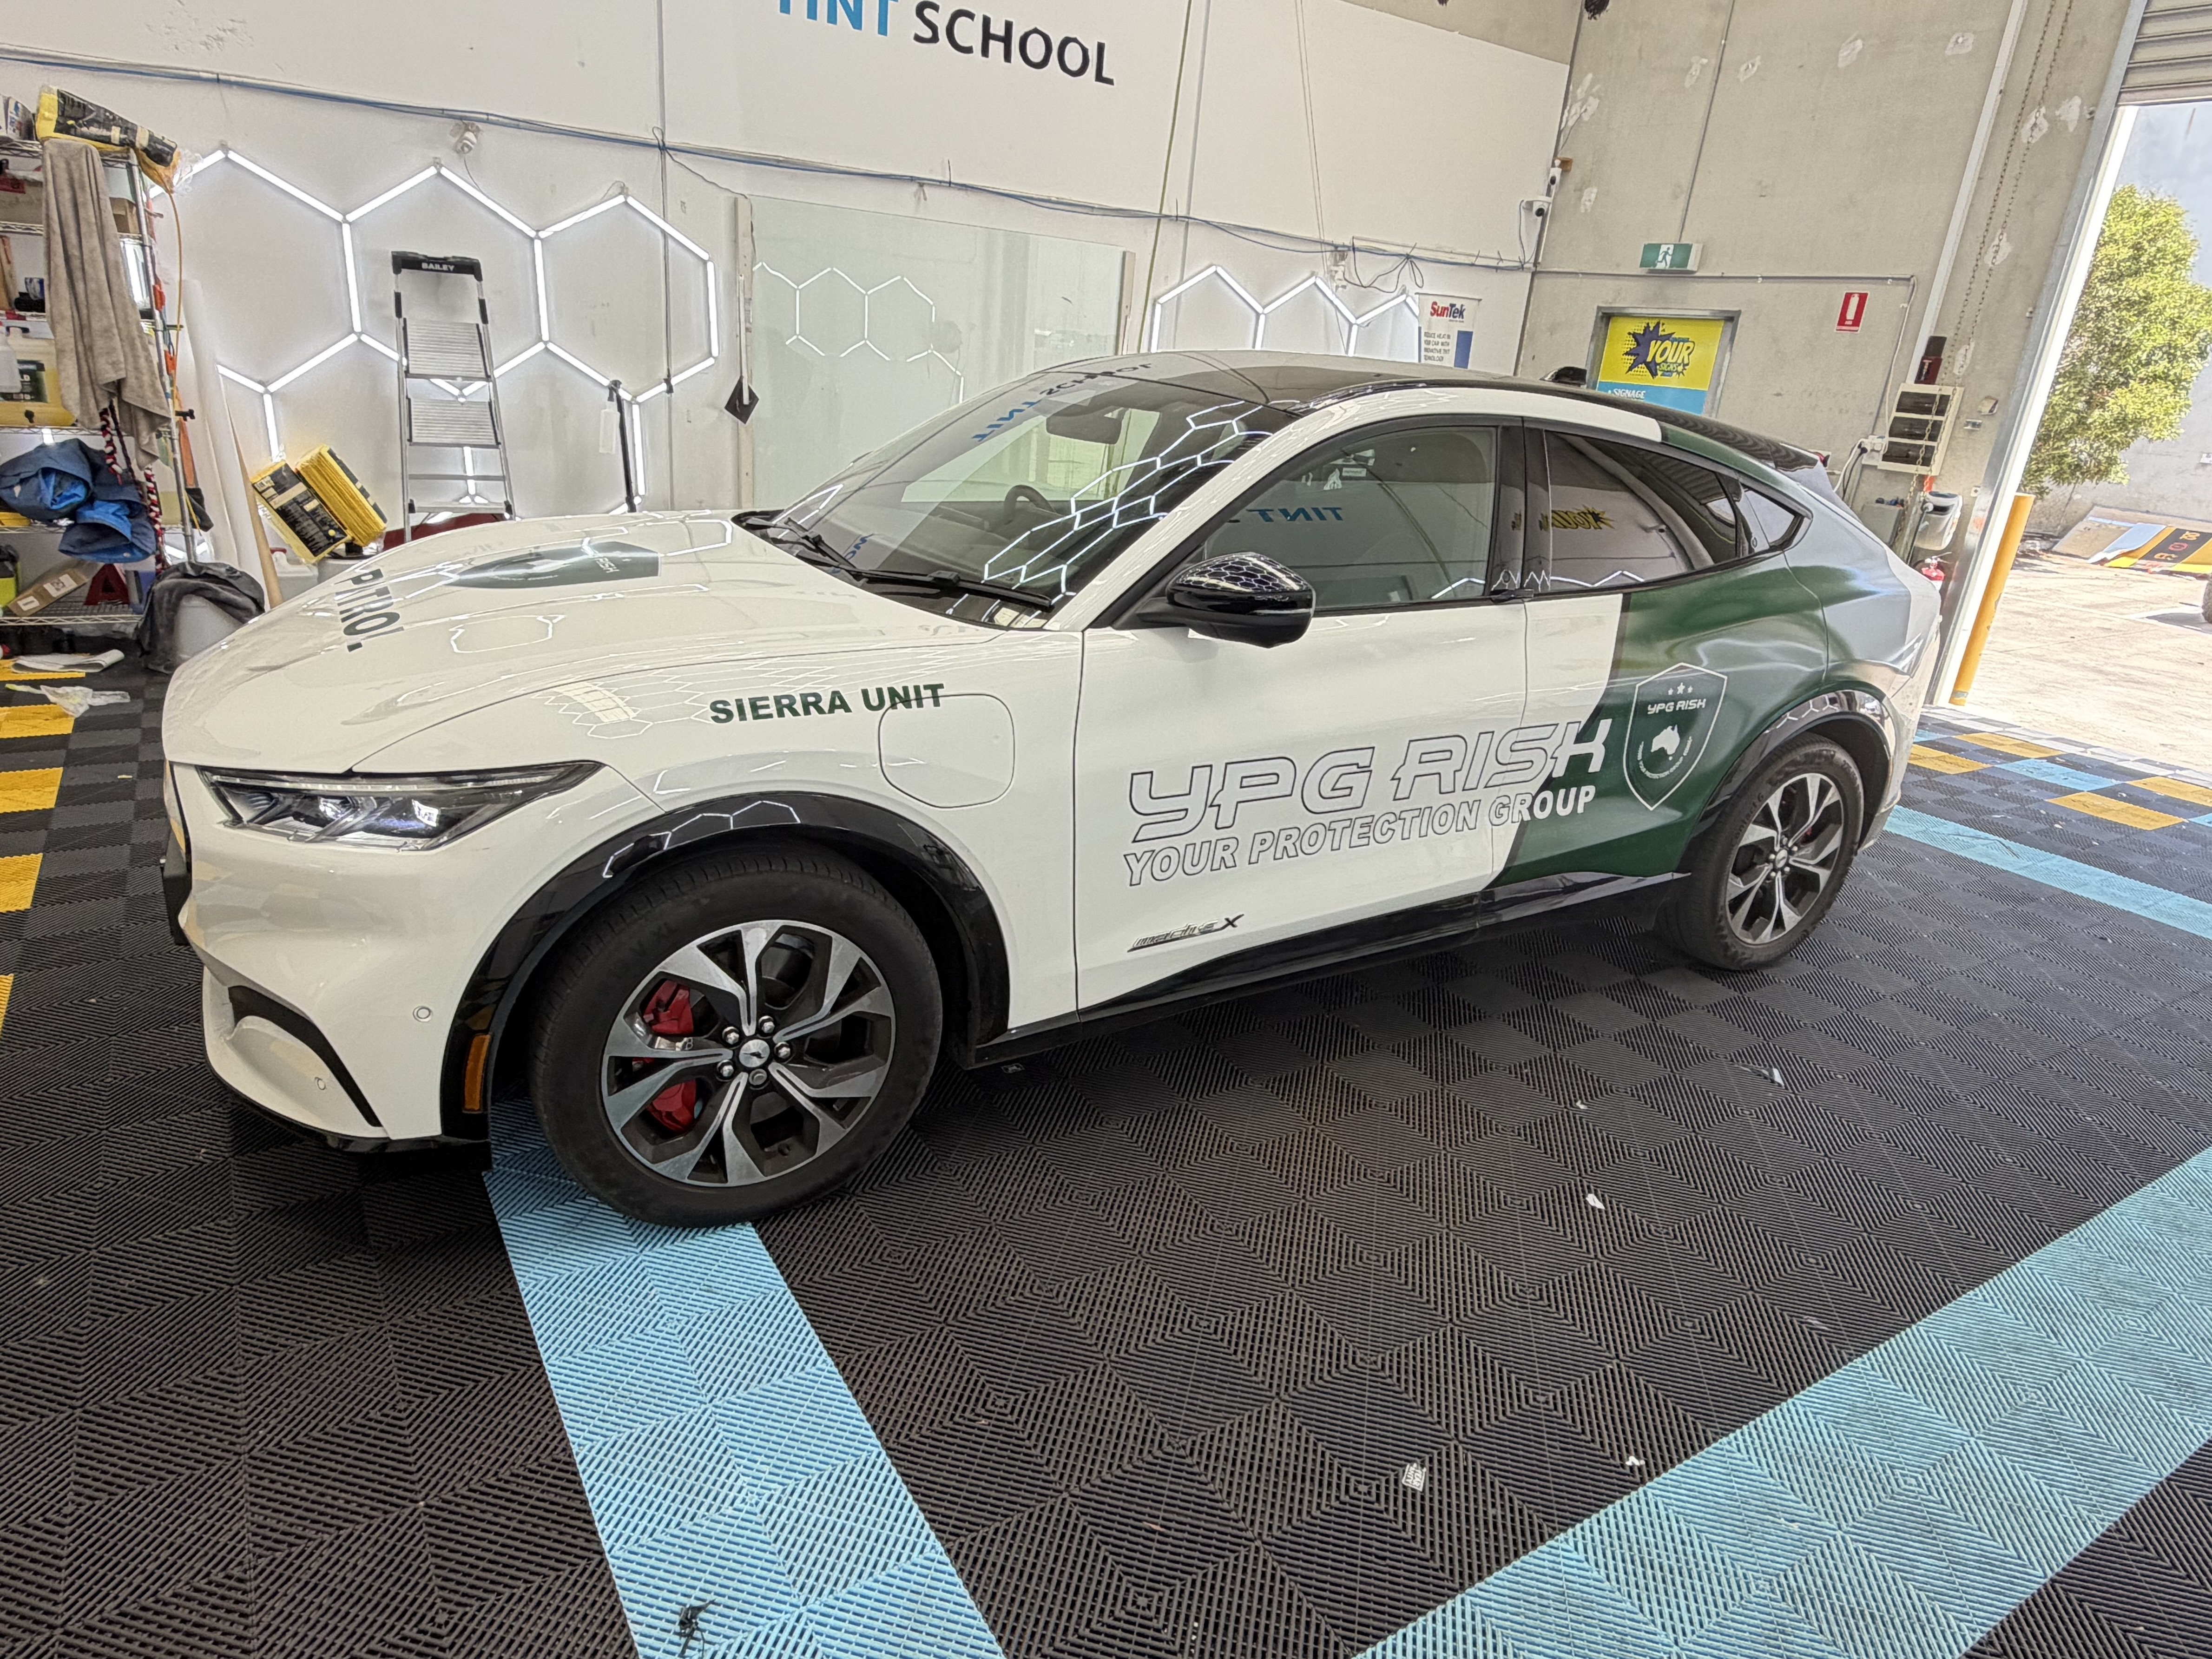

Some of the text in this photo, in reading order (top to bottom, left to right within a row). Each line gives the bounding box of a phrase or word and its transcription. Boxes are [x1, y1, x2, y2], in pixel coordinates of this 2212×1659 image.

[913, 0, 1115, 86] SCHOOL
[421, 263, 455, 271] BAILEY
[1430, 301, 1466, 319] SunTek
[1646, 340, 1695, 364] YOUR
[1613, 388, 1646, 399] SIGNAGE
[710, 683, 945, 724] SIERRA UNIT
[1647, 702, 1675, 715] YPG
[1129, 746, 1376, 843] YPG
[1124, 784, 1596, 887] YOUR PROTECTION GROUP
